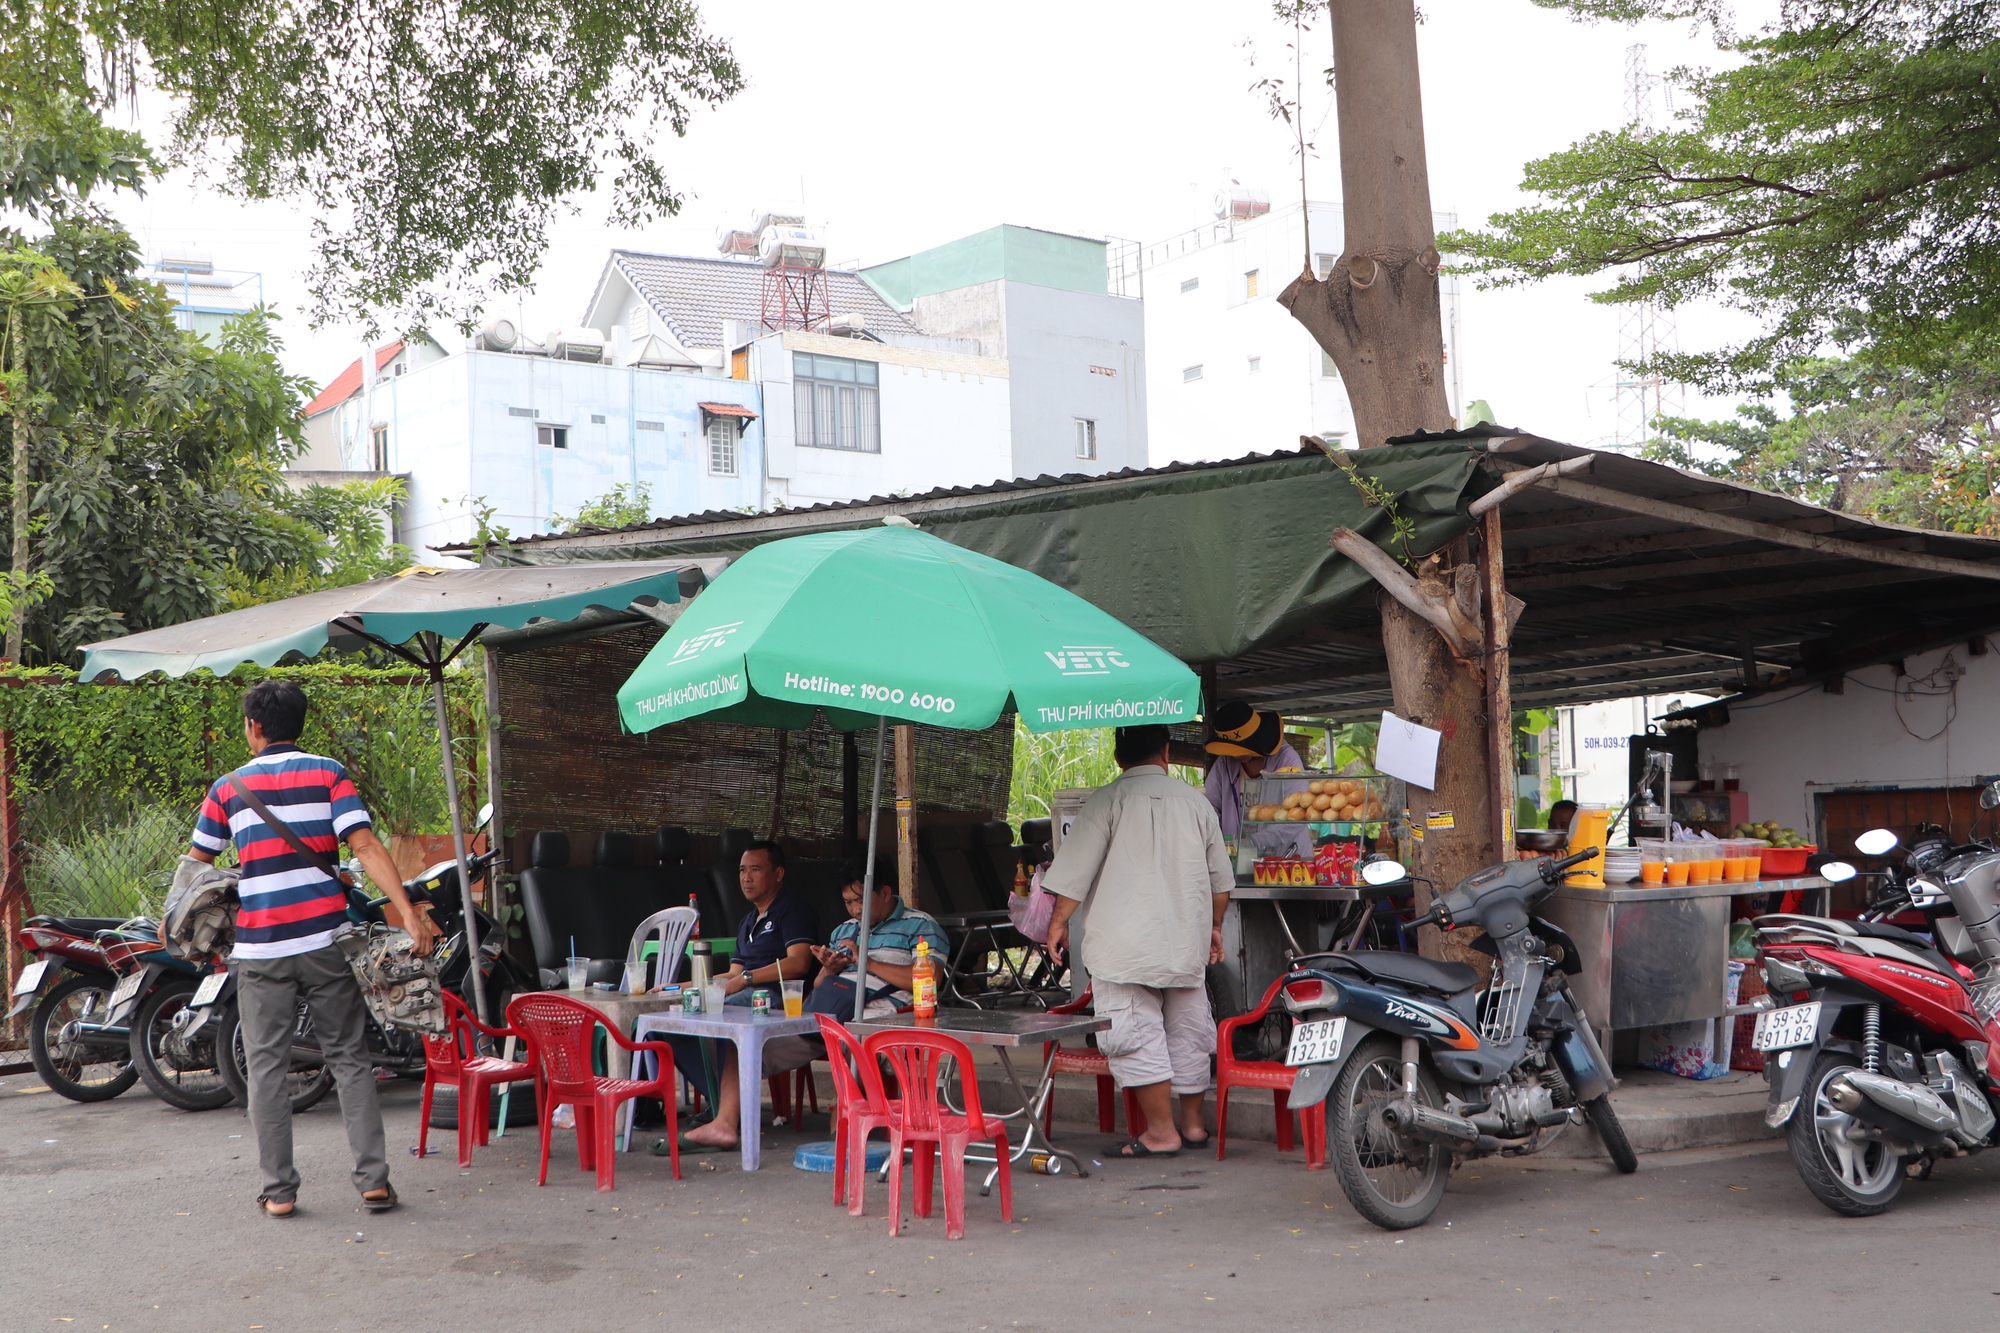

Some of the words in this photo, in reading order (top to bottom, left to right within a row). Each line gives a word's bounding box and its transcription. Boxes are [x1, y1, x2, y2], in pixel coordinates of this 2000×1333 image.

[672, 628, 737, 659] VETC
[1043, 651, 1130, 669] VETC
[635, 695, 656, 716] THU
[657, 687, 673, 711] PHÍ
[674, 682, 708, 706] KHÔNG
[784, 672, 856, 697] Hotline:
[860, 683, 905, 704] 1900
[909, 692, 956, 713] 6010
[1038, 705, 1065, 723] THU
[1068, 700, 1092, 721] PHÍ
[1095, 698, 1144, 719] KHÔNG
[1385, 1001, 1417, 1021] Viva
[1773, 1006, 1812, 1029] 59-S2
[1298, 1020, 1336, 1043] 85-B1
[1763, 1024, 1812, 1048] 911.82
[1291, 1039, 1338, 1063] 132.19
